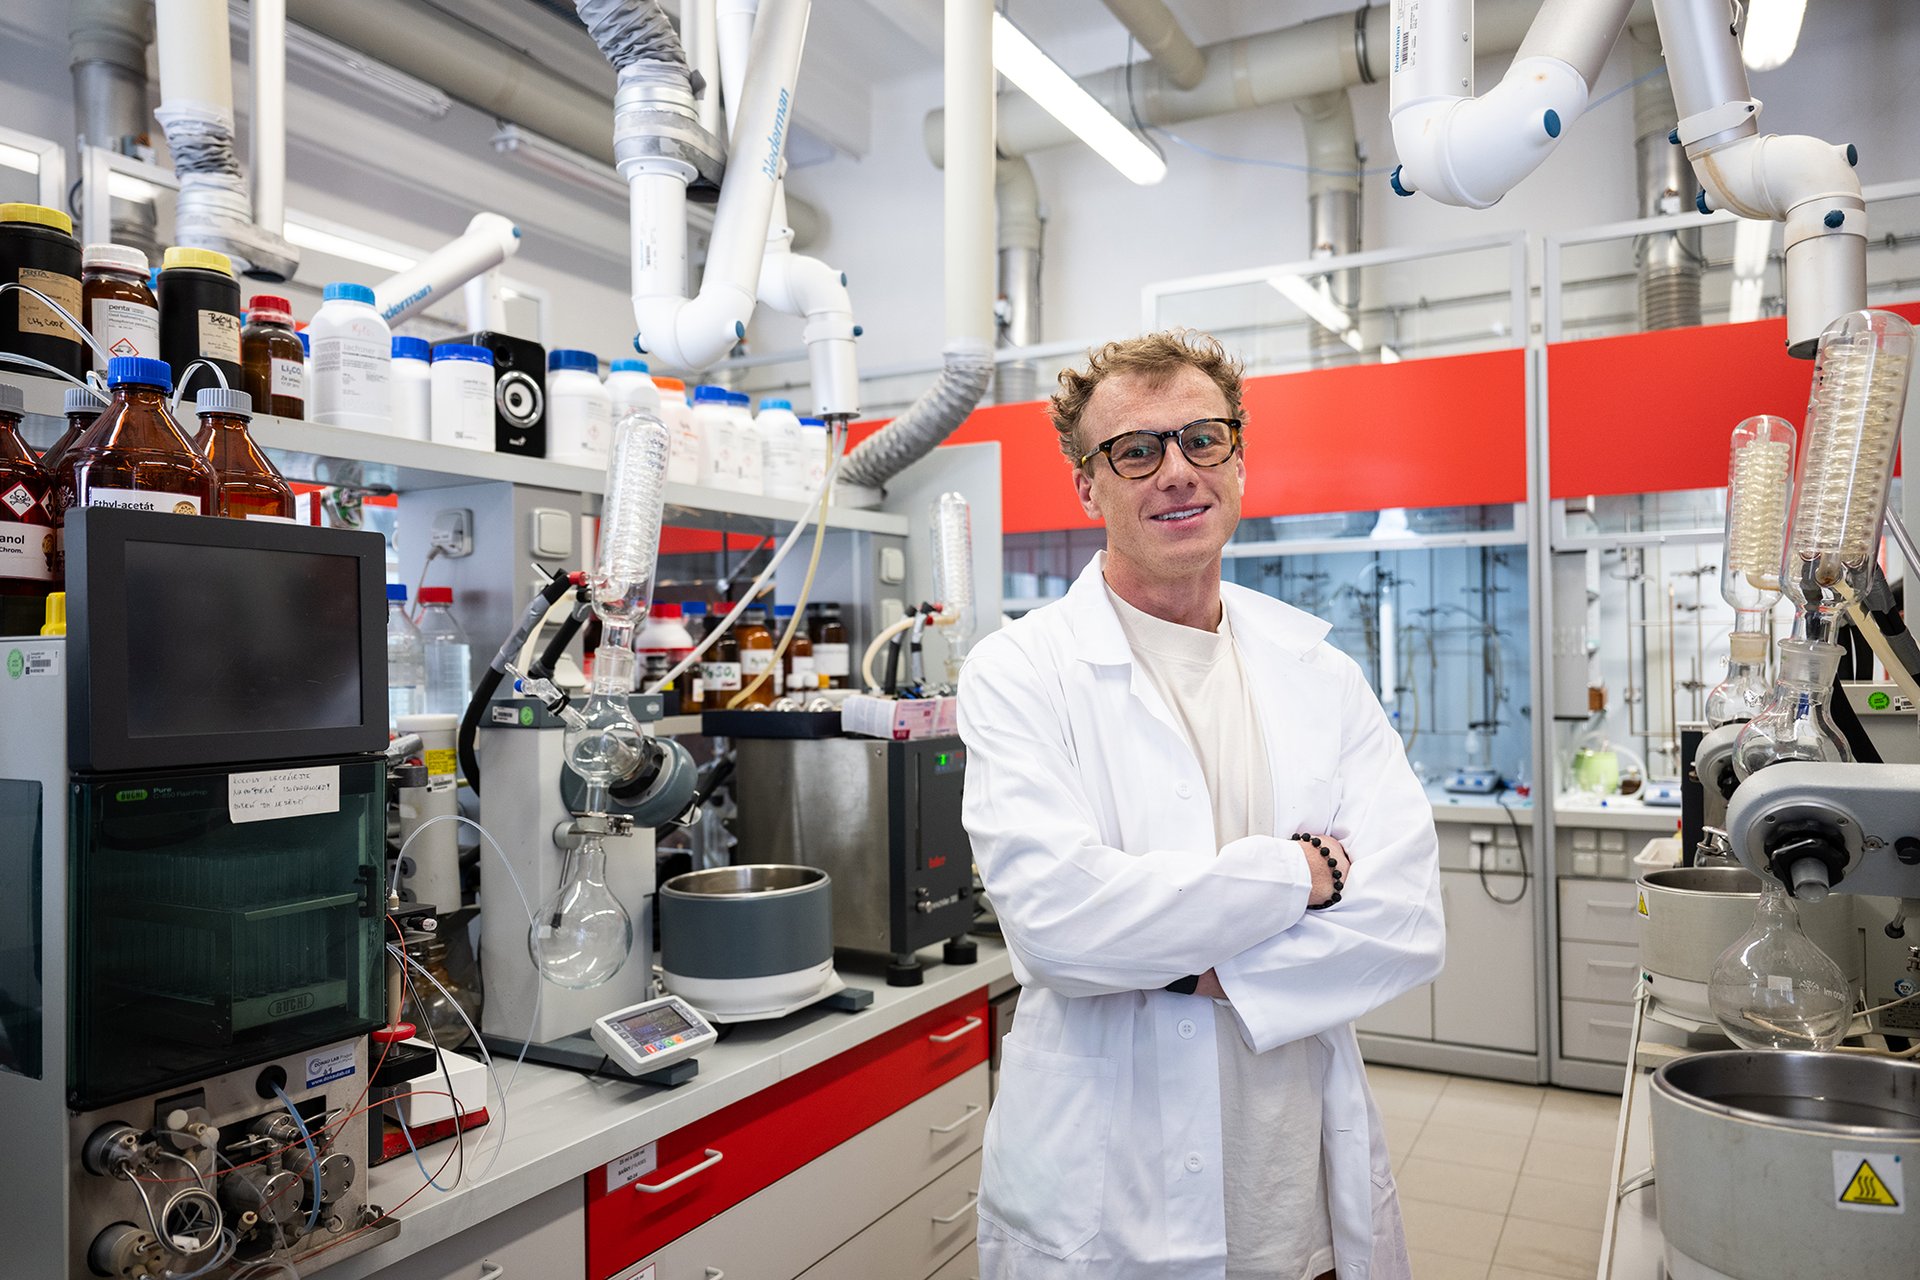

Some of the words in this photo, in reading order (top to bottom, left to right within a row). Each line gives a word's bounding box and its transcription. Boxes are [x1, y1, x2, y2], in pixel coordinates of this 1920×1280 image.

[761, 87, 790, 182] Nederman
[108, 304, 131, 312] penta
[380, 284, 433, 320] derman
[93, 499, 155, 512] Ethyl-acetát
